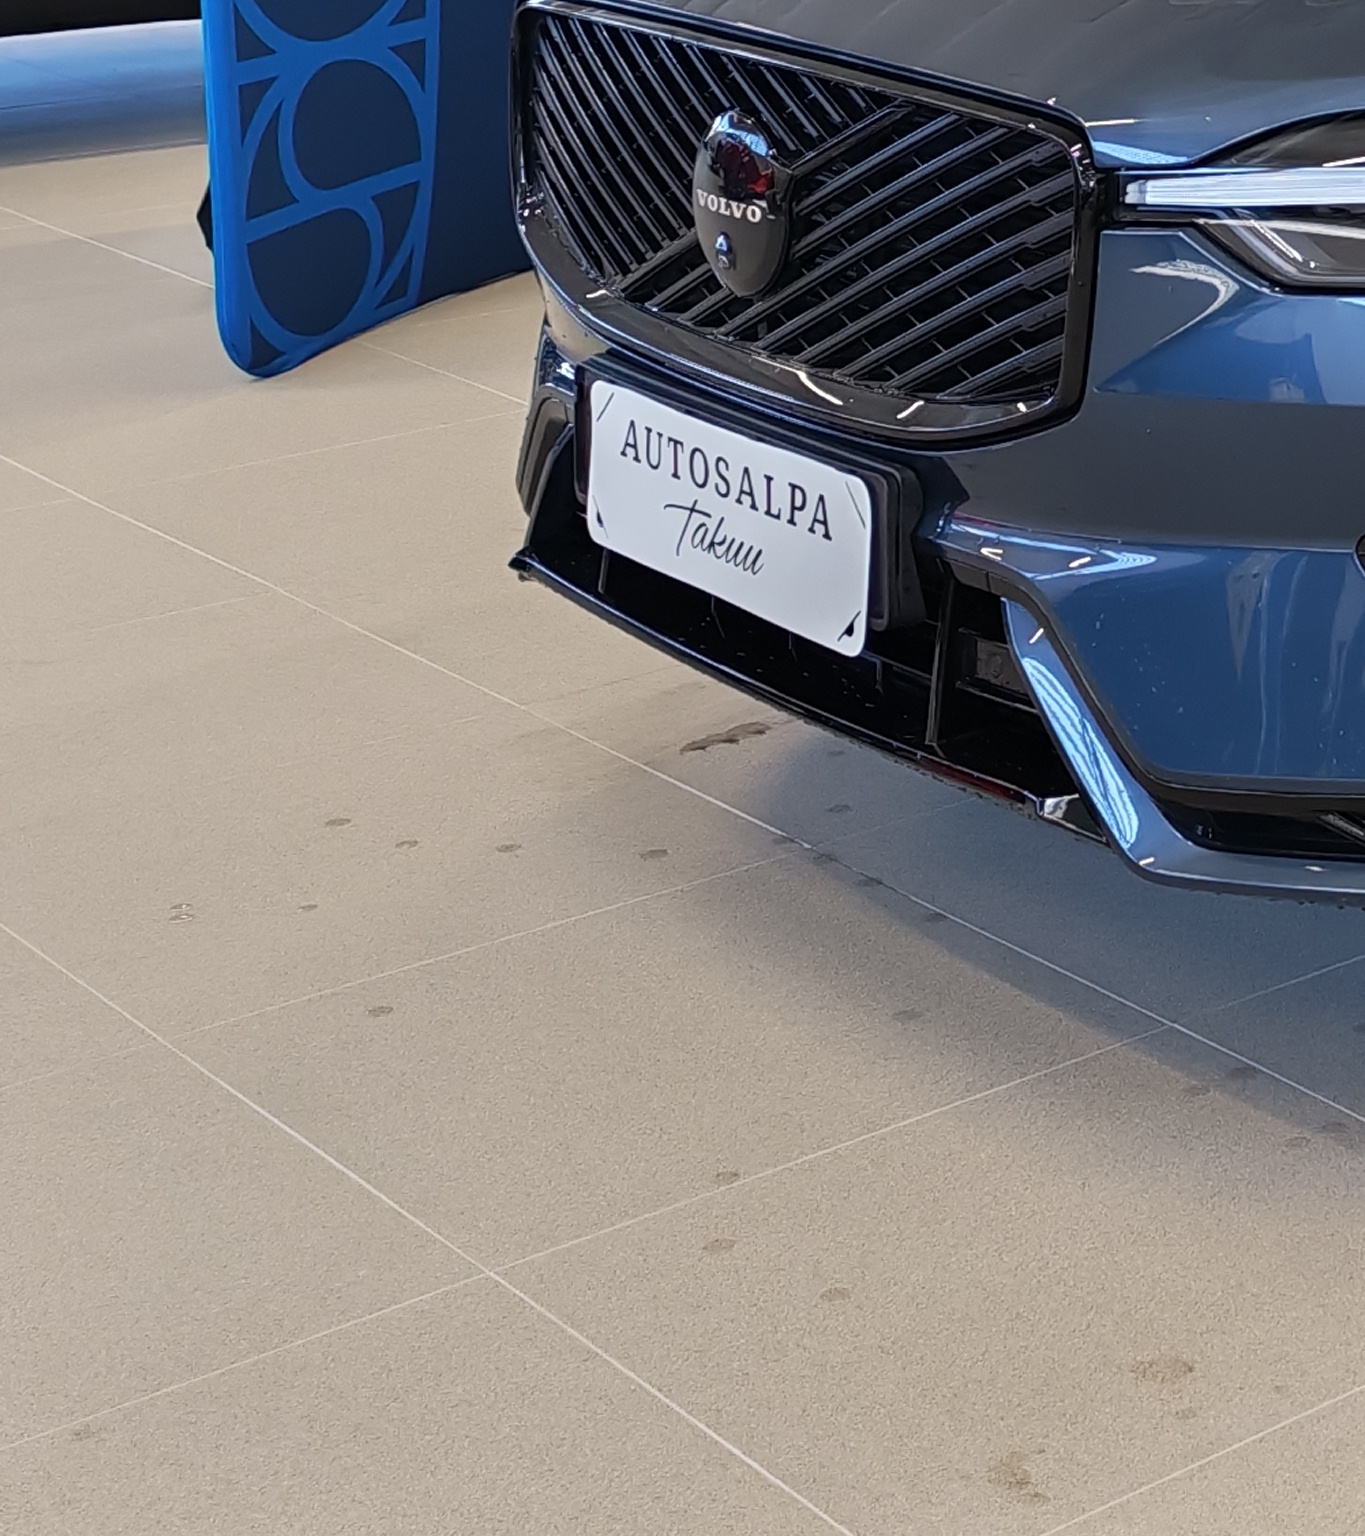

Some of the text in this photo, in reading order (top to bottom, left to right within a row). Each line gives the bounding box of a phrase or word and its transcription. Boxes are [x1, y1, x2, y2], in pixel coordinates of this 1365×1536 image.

[696, 188, 762, 223] VOLVO
[619, 419, 833, 542] AUTOSALPA
[663, 498, 764, 576] Takuu
